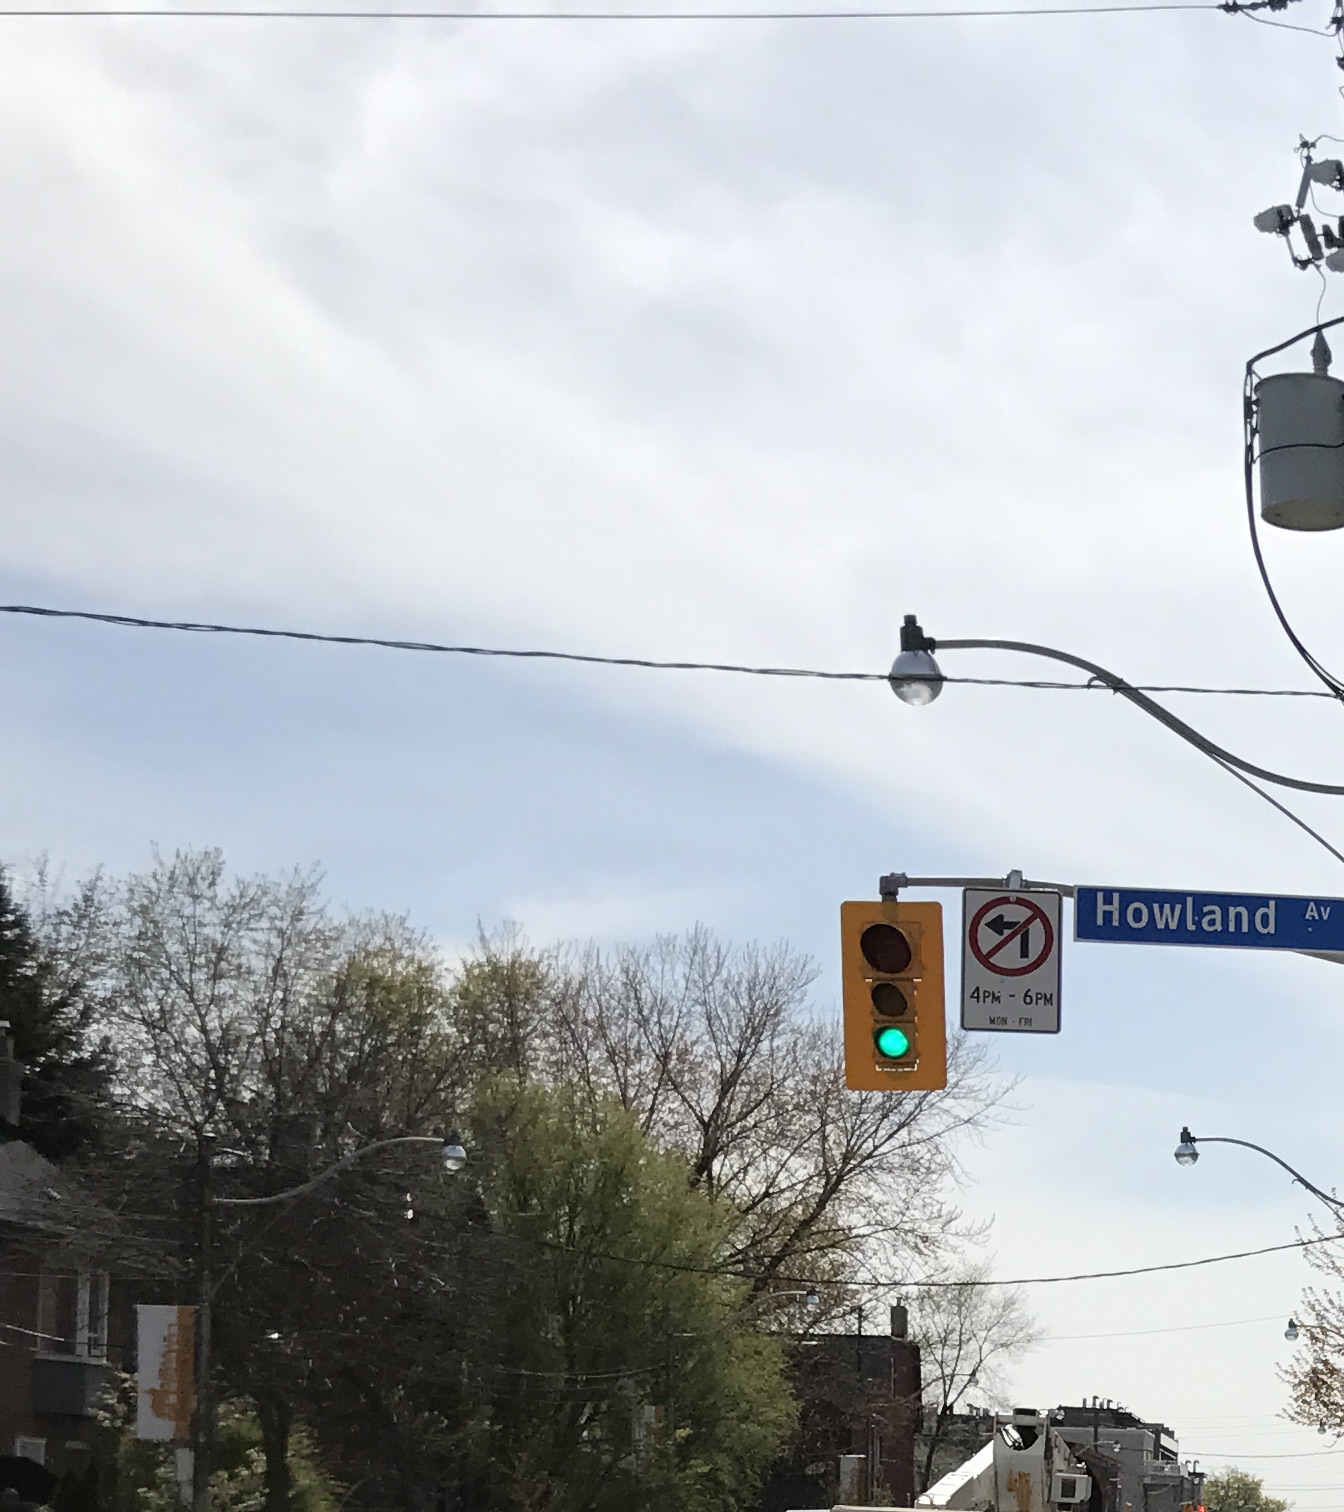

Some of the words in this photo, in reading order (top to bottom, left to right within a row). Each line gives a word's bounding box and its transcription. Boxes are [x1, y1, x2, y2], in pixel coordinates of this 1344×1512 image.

[1096, 891, 1276, 935] Howland
[1304, 901, 1331, 921] Av
[970, 985, 1002, 1004] 4PM
[1022, 988, 1054, 1006] 6PM
[988, 1016, 1008, 1026] MON
